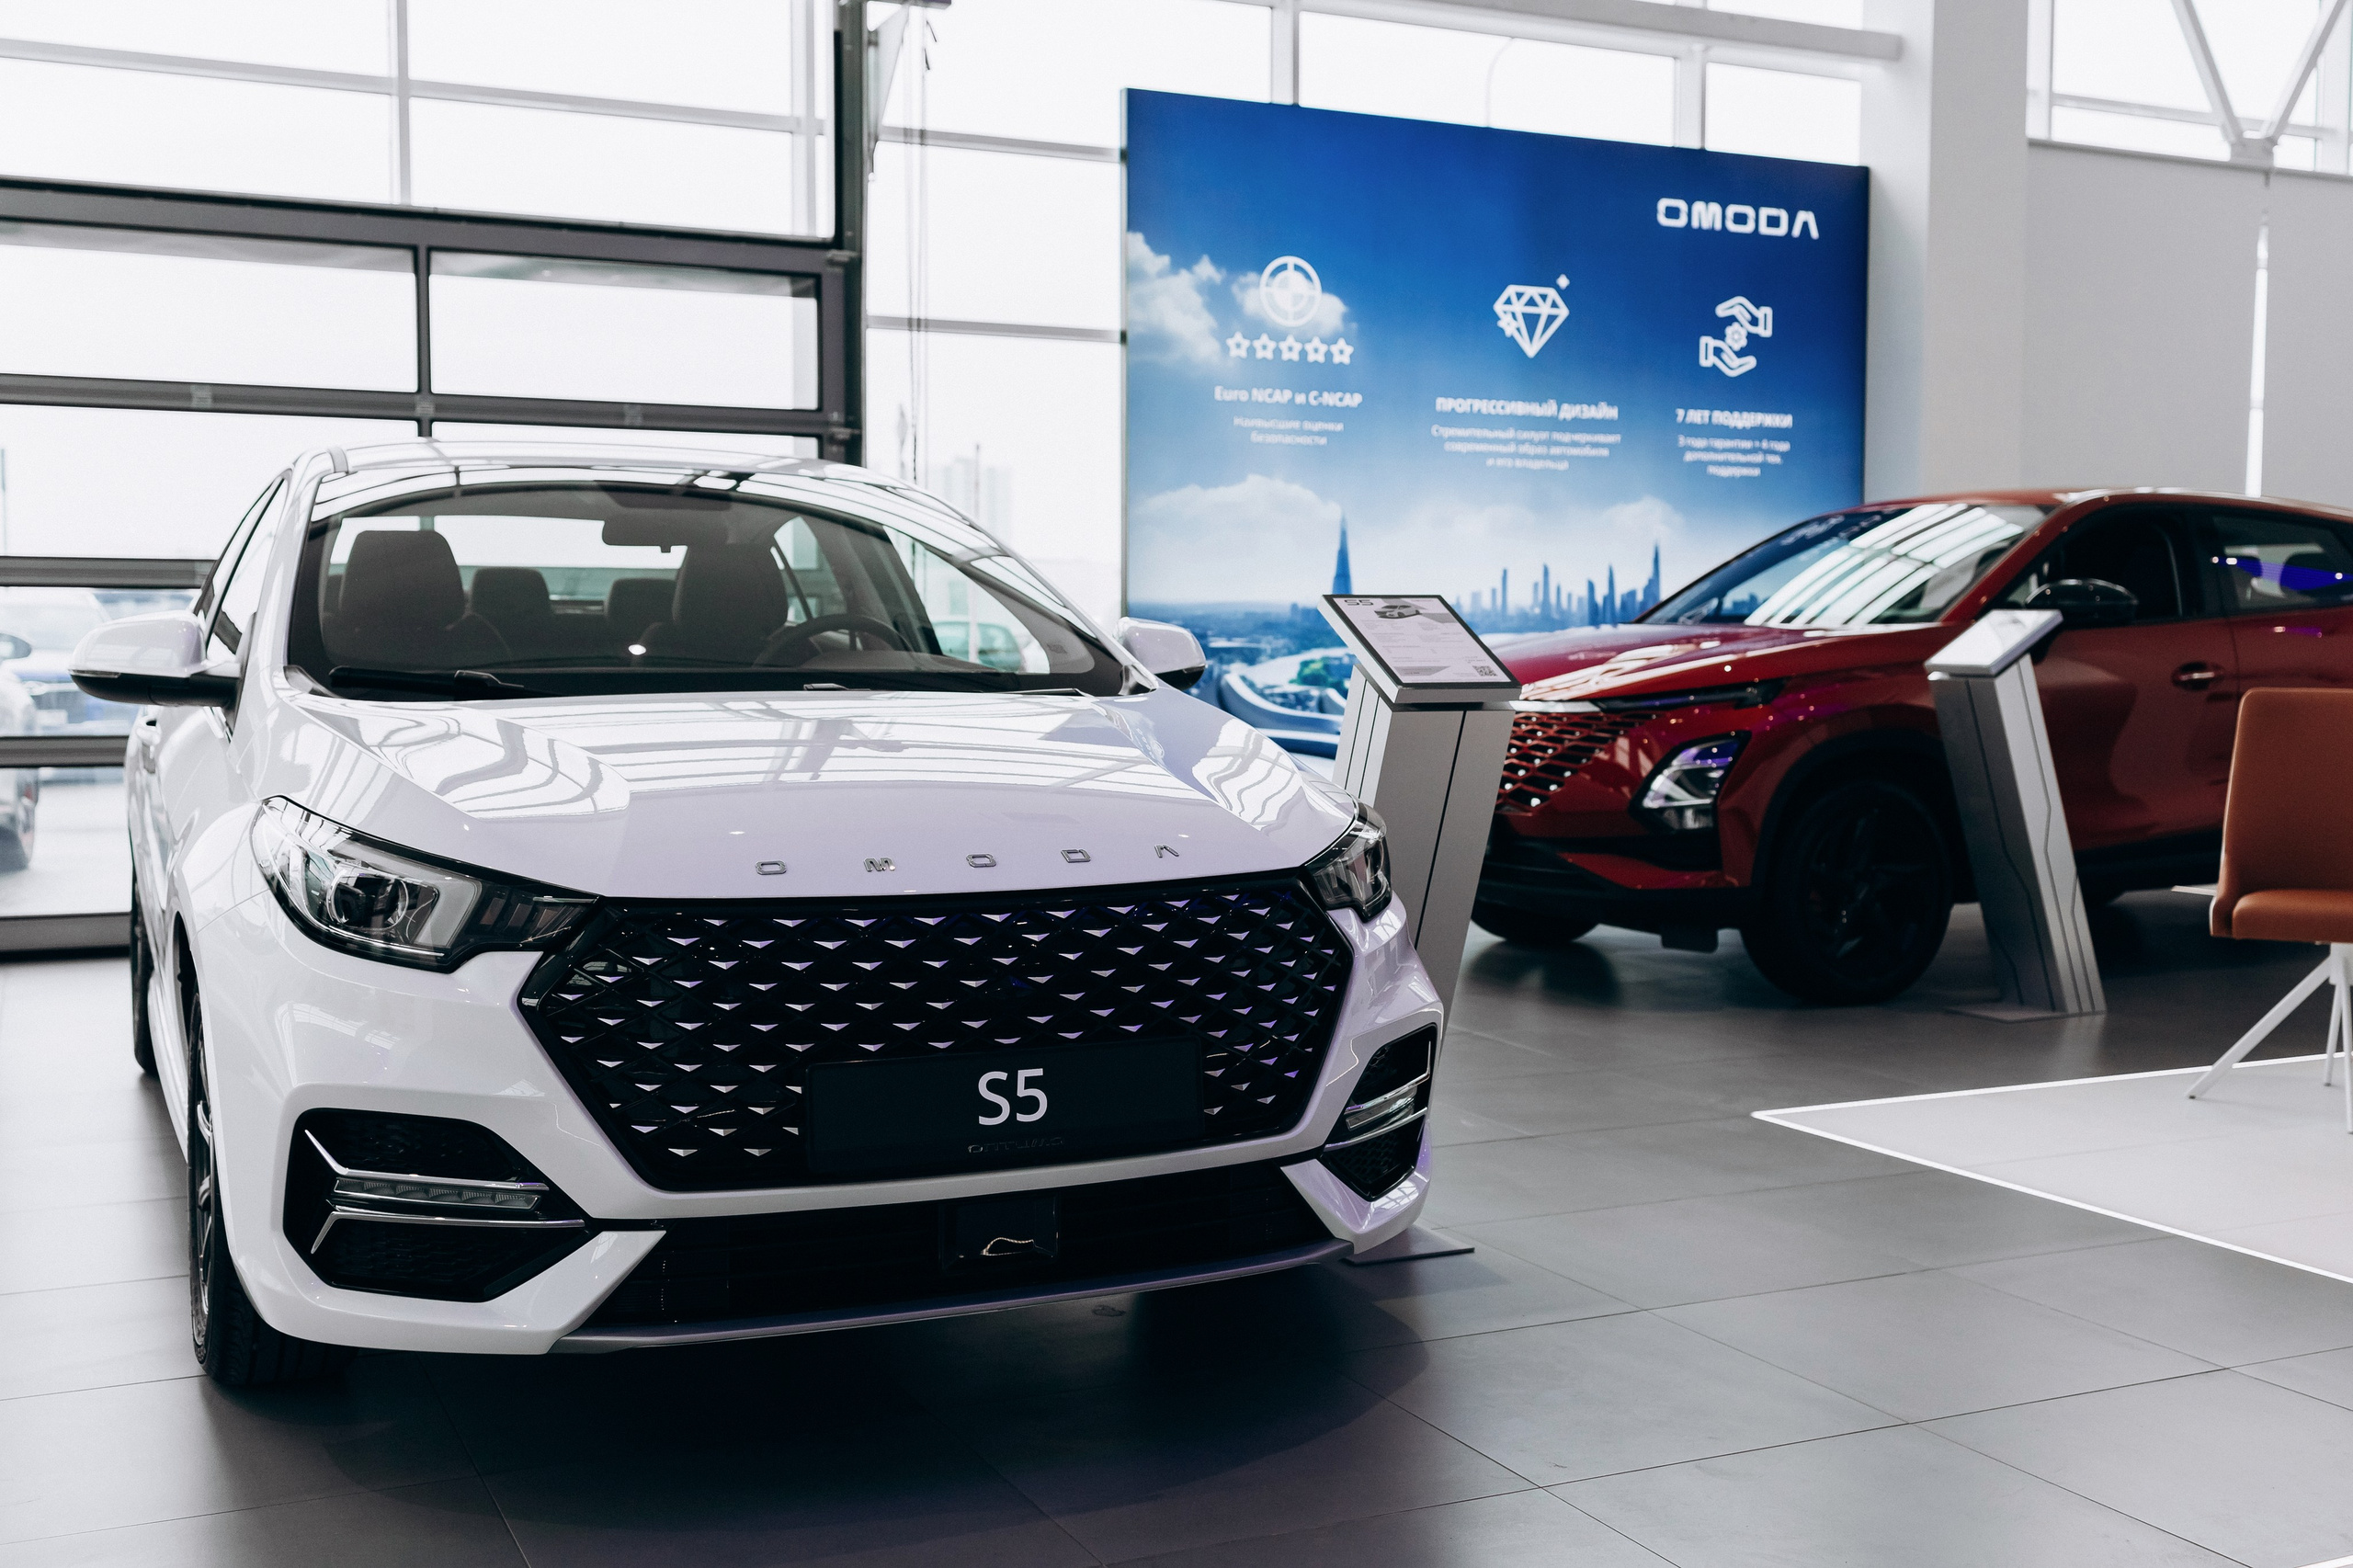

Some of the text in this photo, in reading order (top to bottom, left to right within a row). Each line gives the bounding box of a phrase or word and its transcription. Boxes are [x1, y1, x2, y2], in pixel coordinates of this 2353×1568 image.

[1656, 197, 1820, 240] OMODA
[1214, 385, 1363, 408] Euro NCAP и C-NCAP
[1435, 396, 1619, 422] ПРОГРЕССИВНЫЙ ДИЗАЙН
[1675, 408, 1793, 429] 7 ЛЕТ ПОДДЕРЖКИ
[977, 1067, 1049, 1127] S5
